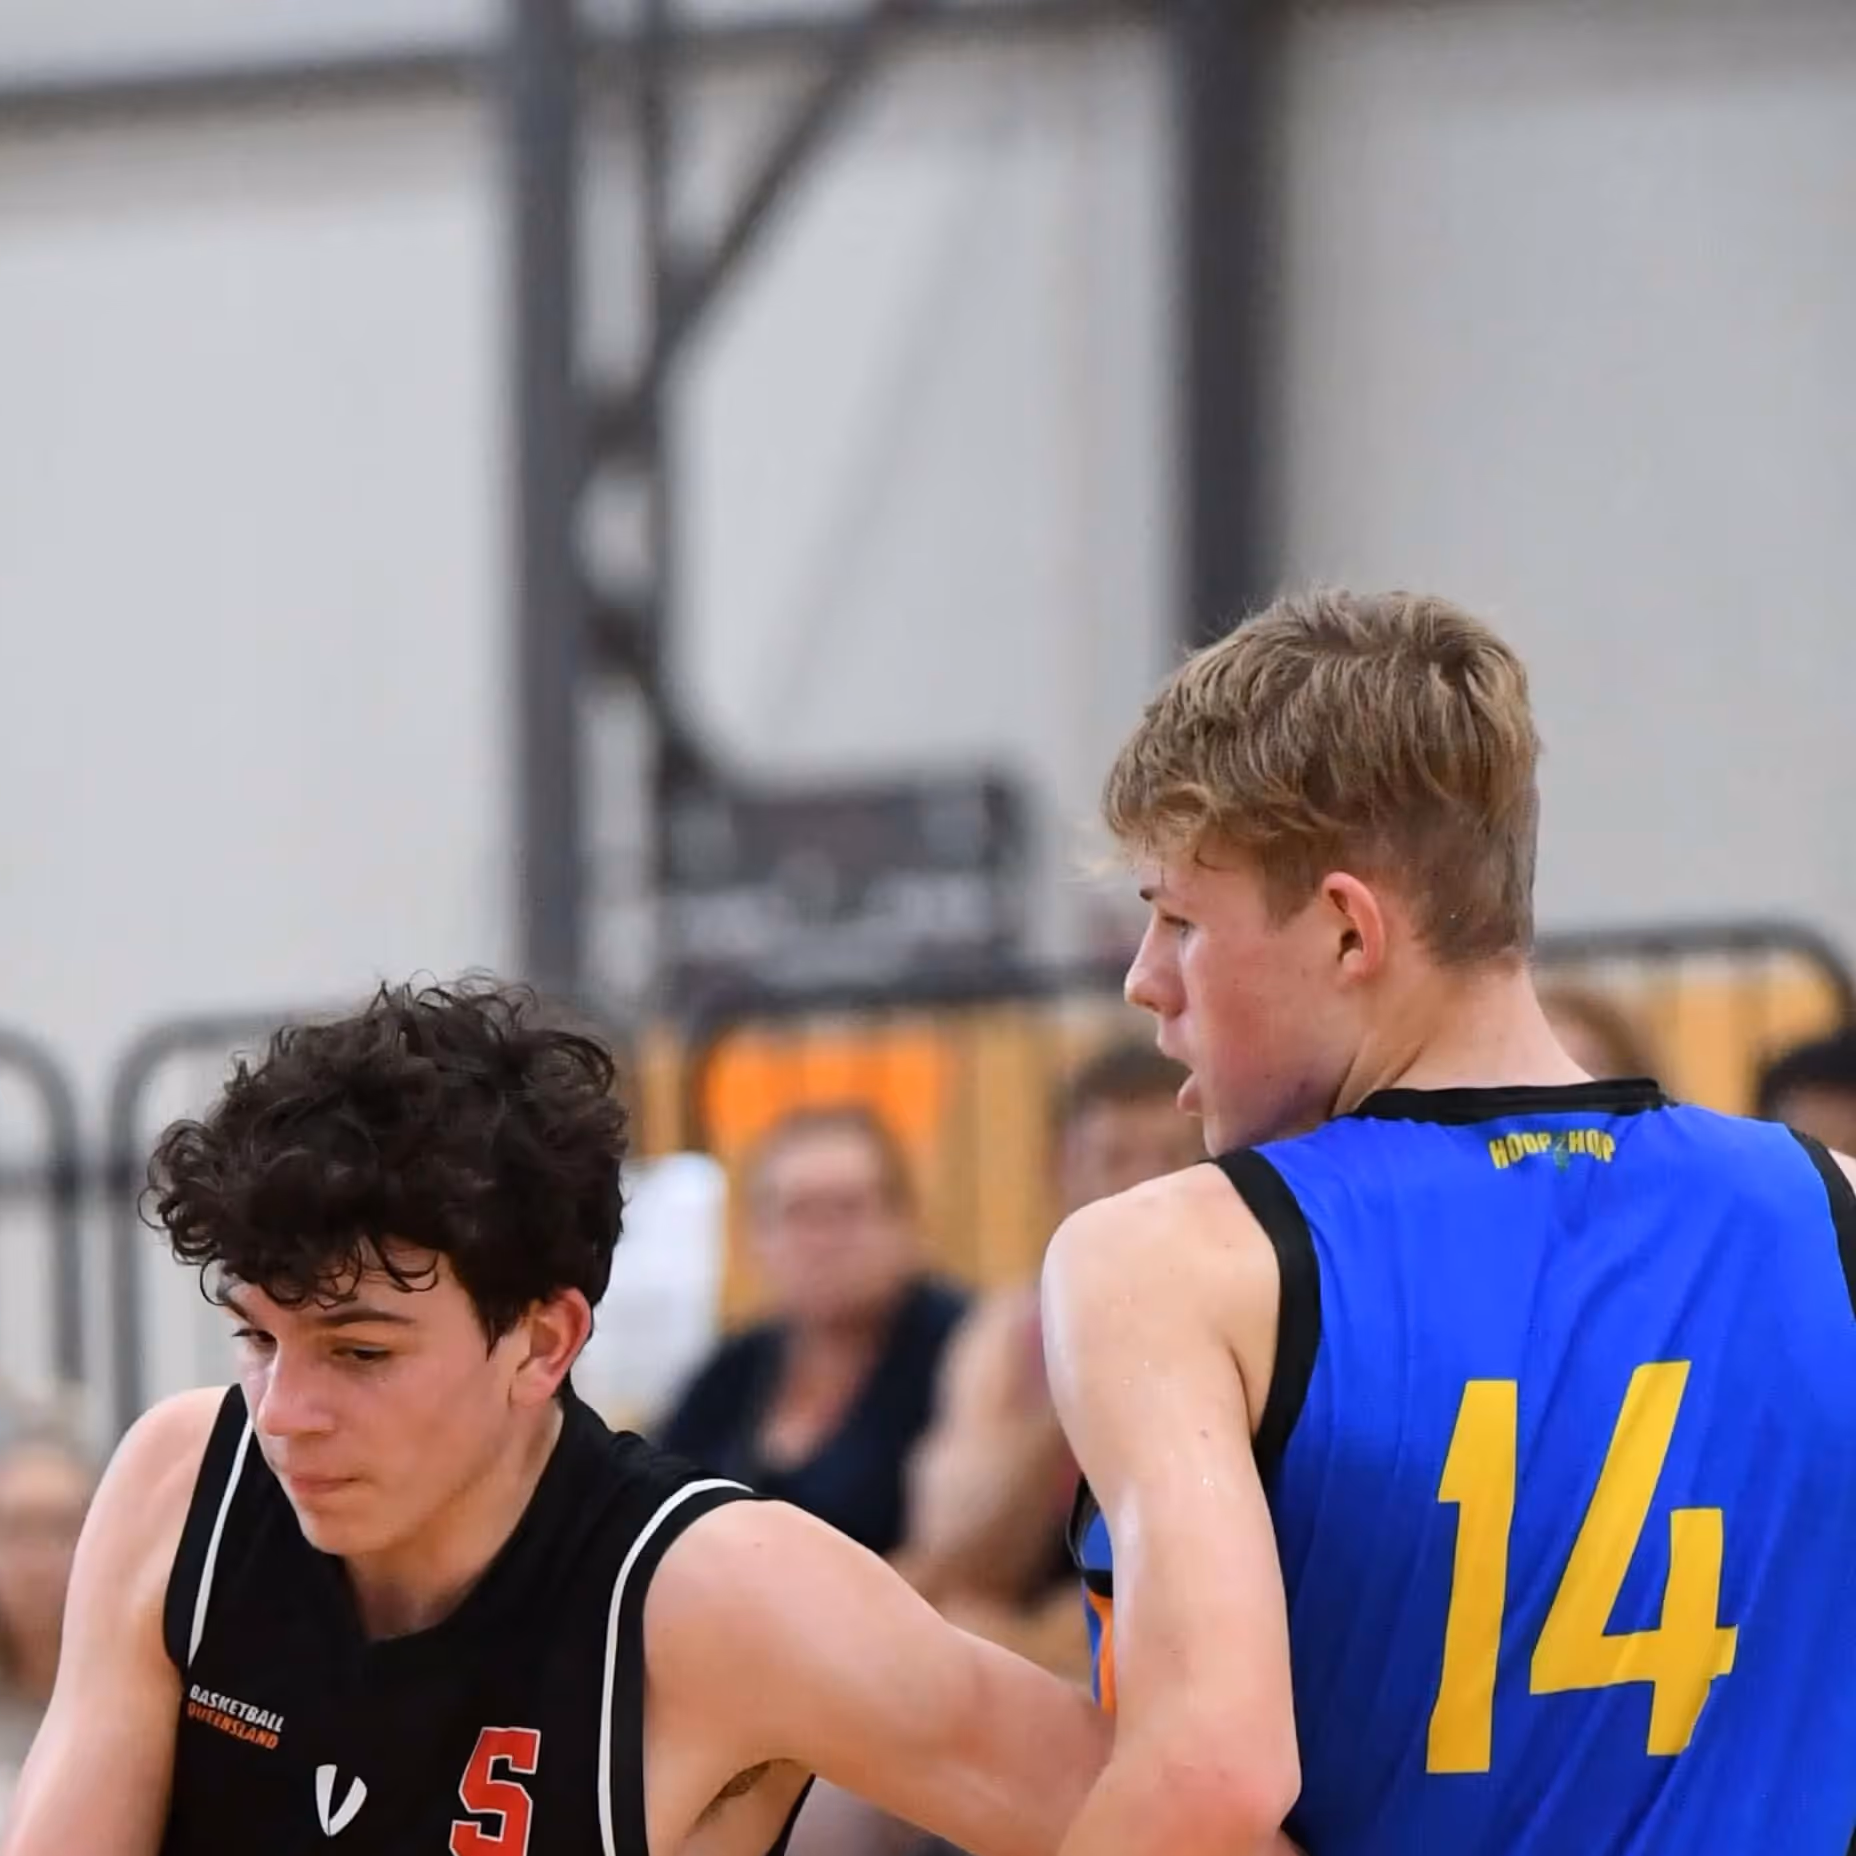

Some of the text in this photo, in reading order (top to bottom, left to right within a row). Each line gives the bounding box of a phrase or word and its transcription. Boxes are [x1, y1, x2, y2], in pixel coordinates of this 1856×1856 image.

[1489, 1132, 1552, 1169] HOOP
[1569, 1128, 1616, 1163] HOP
[1426, 1360, 1739, 1774] 14
[187, 1702, 279, 1751] QUEENSLAND
[189, 1683, 284, 1733] BASKETBALL
